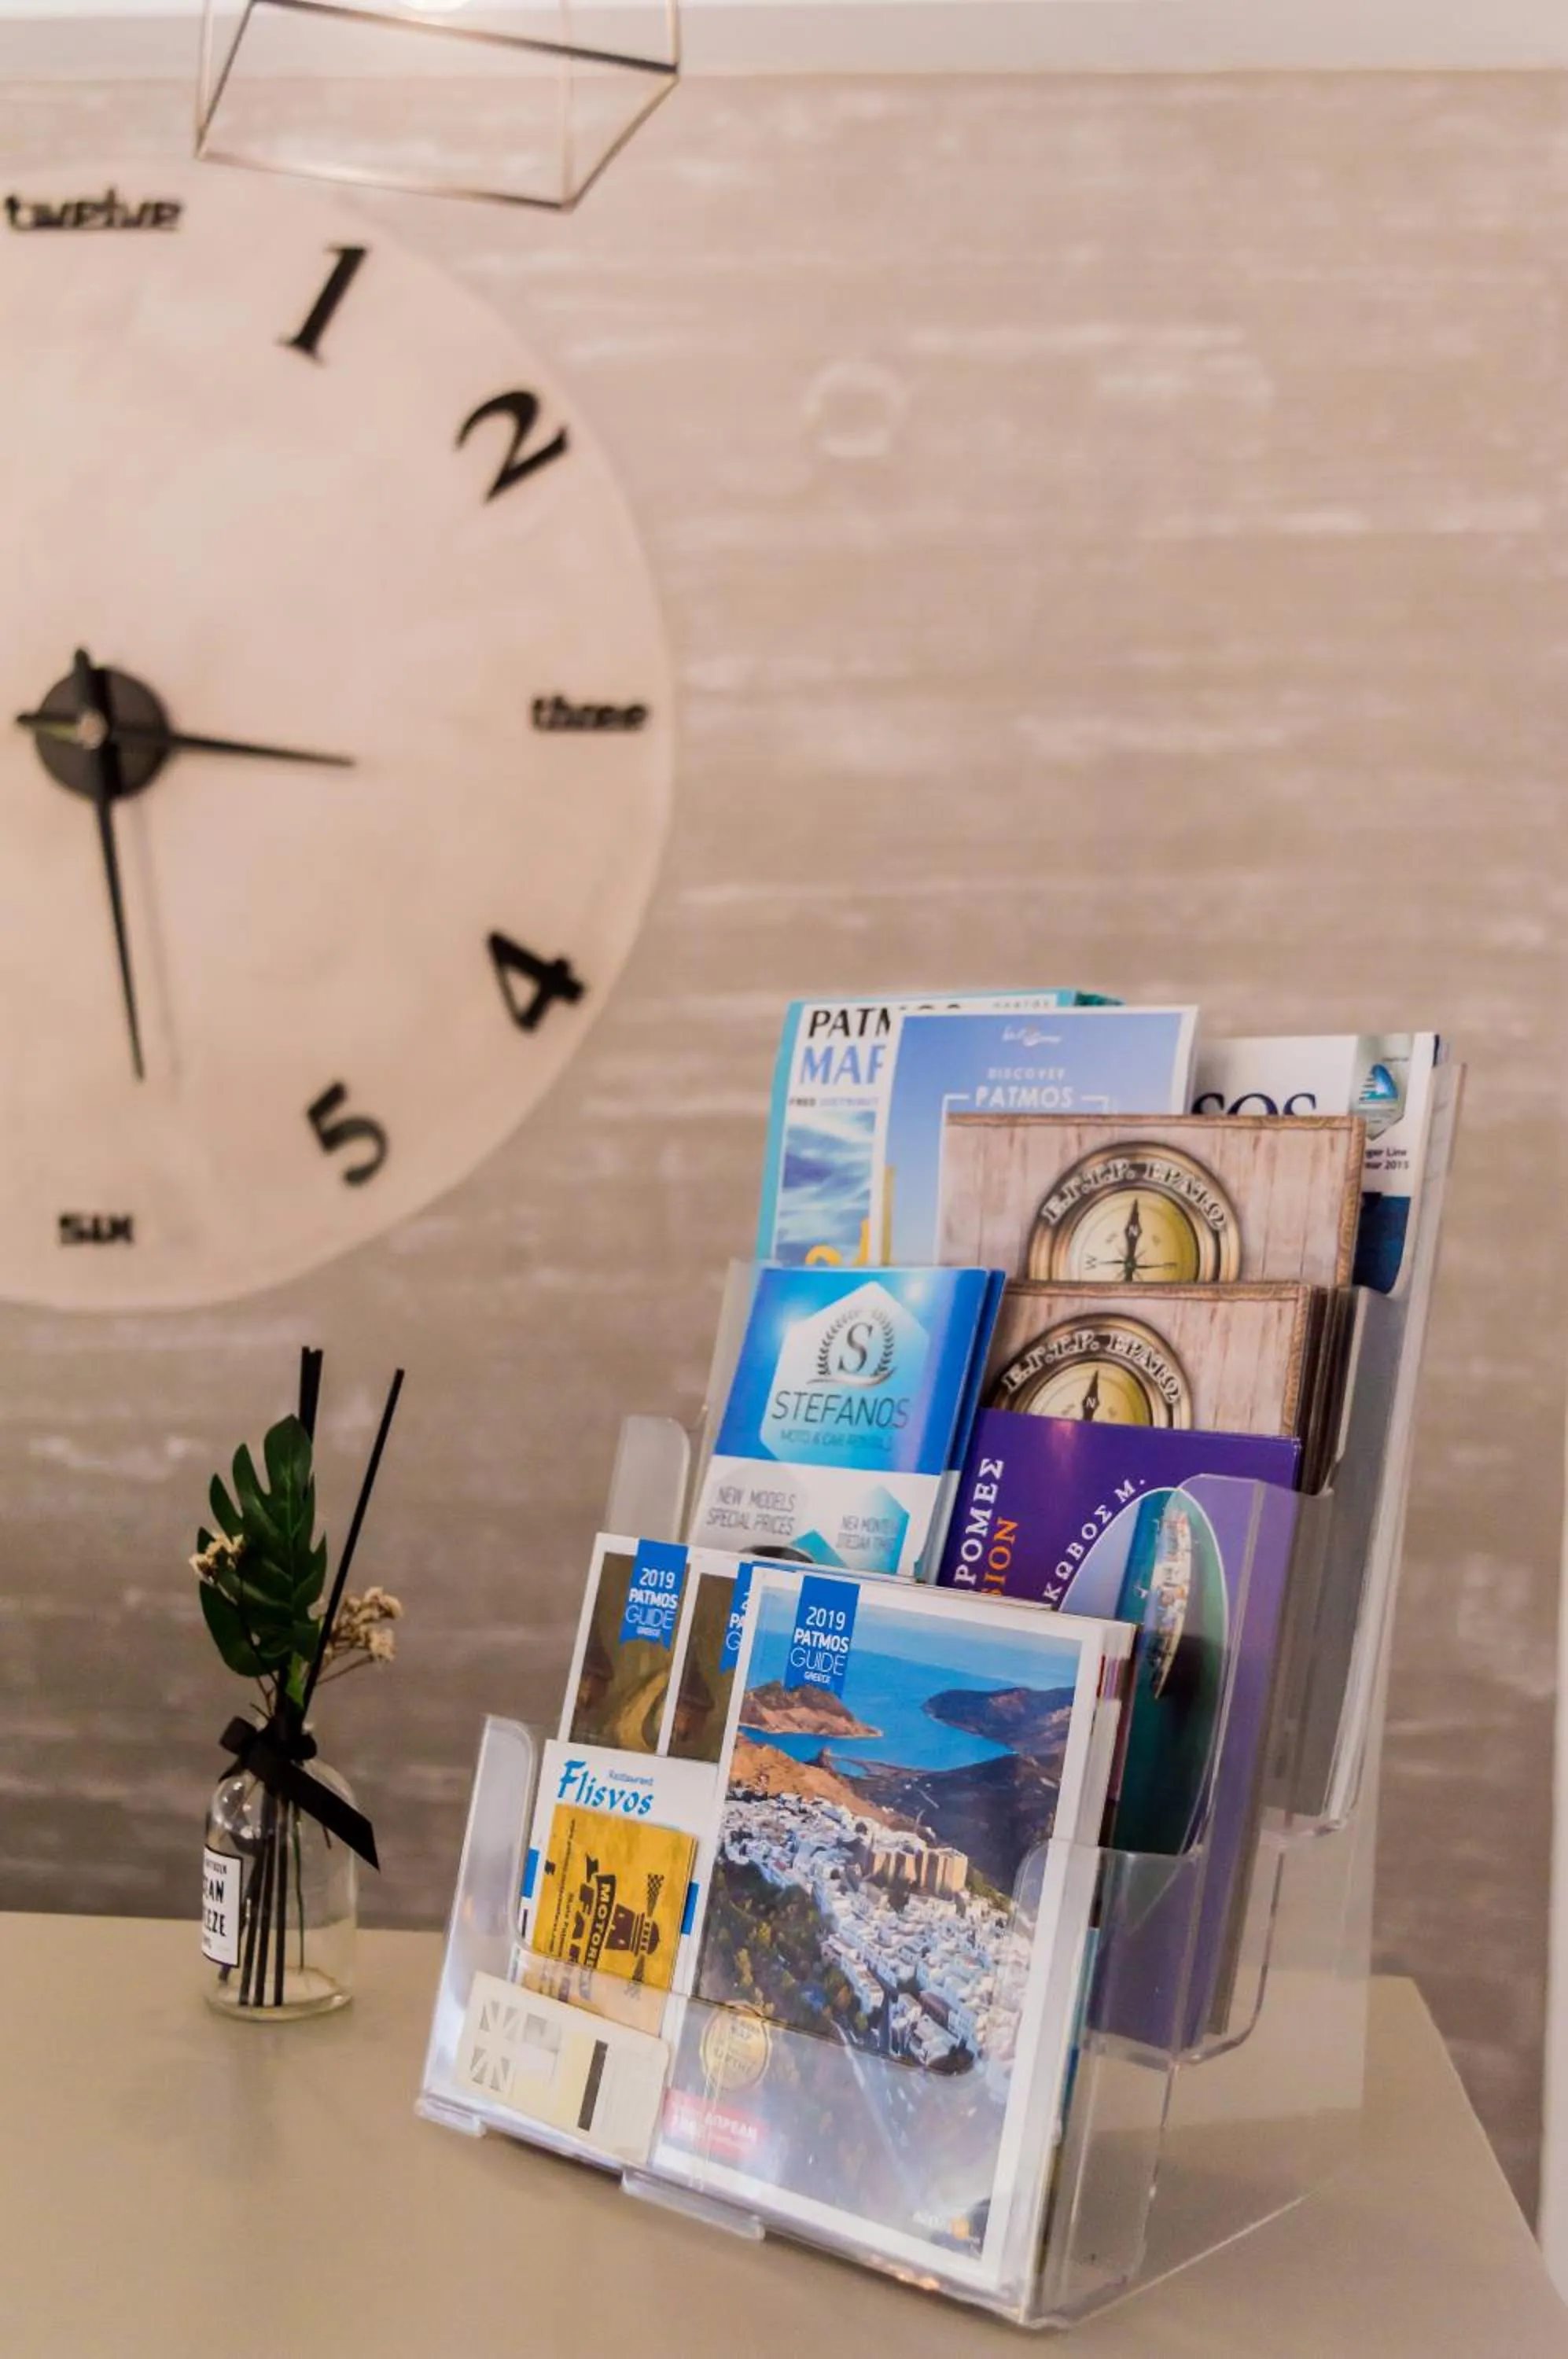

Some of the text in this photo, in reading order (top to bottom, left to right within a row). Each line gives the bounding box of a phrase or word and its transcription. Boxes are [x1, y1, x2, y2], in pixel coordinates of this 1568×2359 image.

[277, 245, 369, 366] 1
[454, 390, 569, 506] 2
[486, 929, 586, 1033] 4
[974, 1085, 1074, 1109] PATMOS
[306, 1080, 389, 1187] 5
[837, 1322, 874, 1374] S
[771, 1389, 910, 1429] STEFANOS
[719, 1485, 745, 1506] NEW
[705, 1507, 797, 1536] SPECIAL PRICES
[639, 1567, 675, 1589] 2019
[628, 1588, 679, 1610] PATMOS
[625, 1605, 676, 1629] GUIDE
[805, 1606, 846, 1631] 2019
[793, 1627, 850, 1654] PATMOS
[790, 1647, 846, 1676] GUIDE
[557, 1759, 654, 1816] Flisvos
